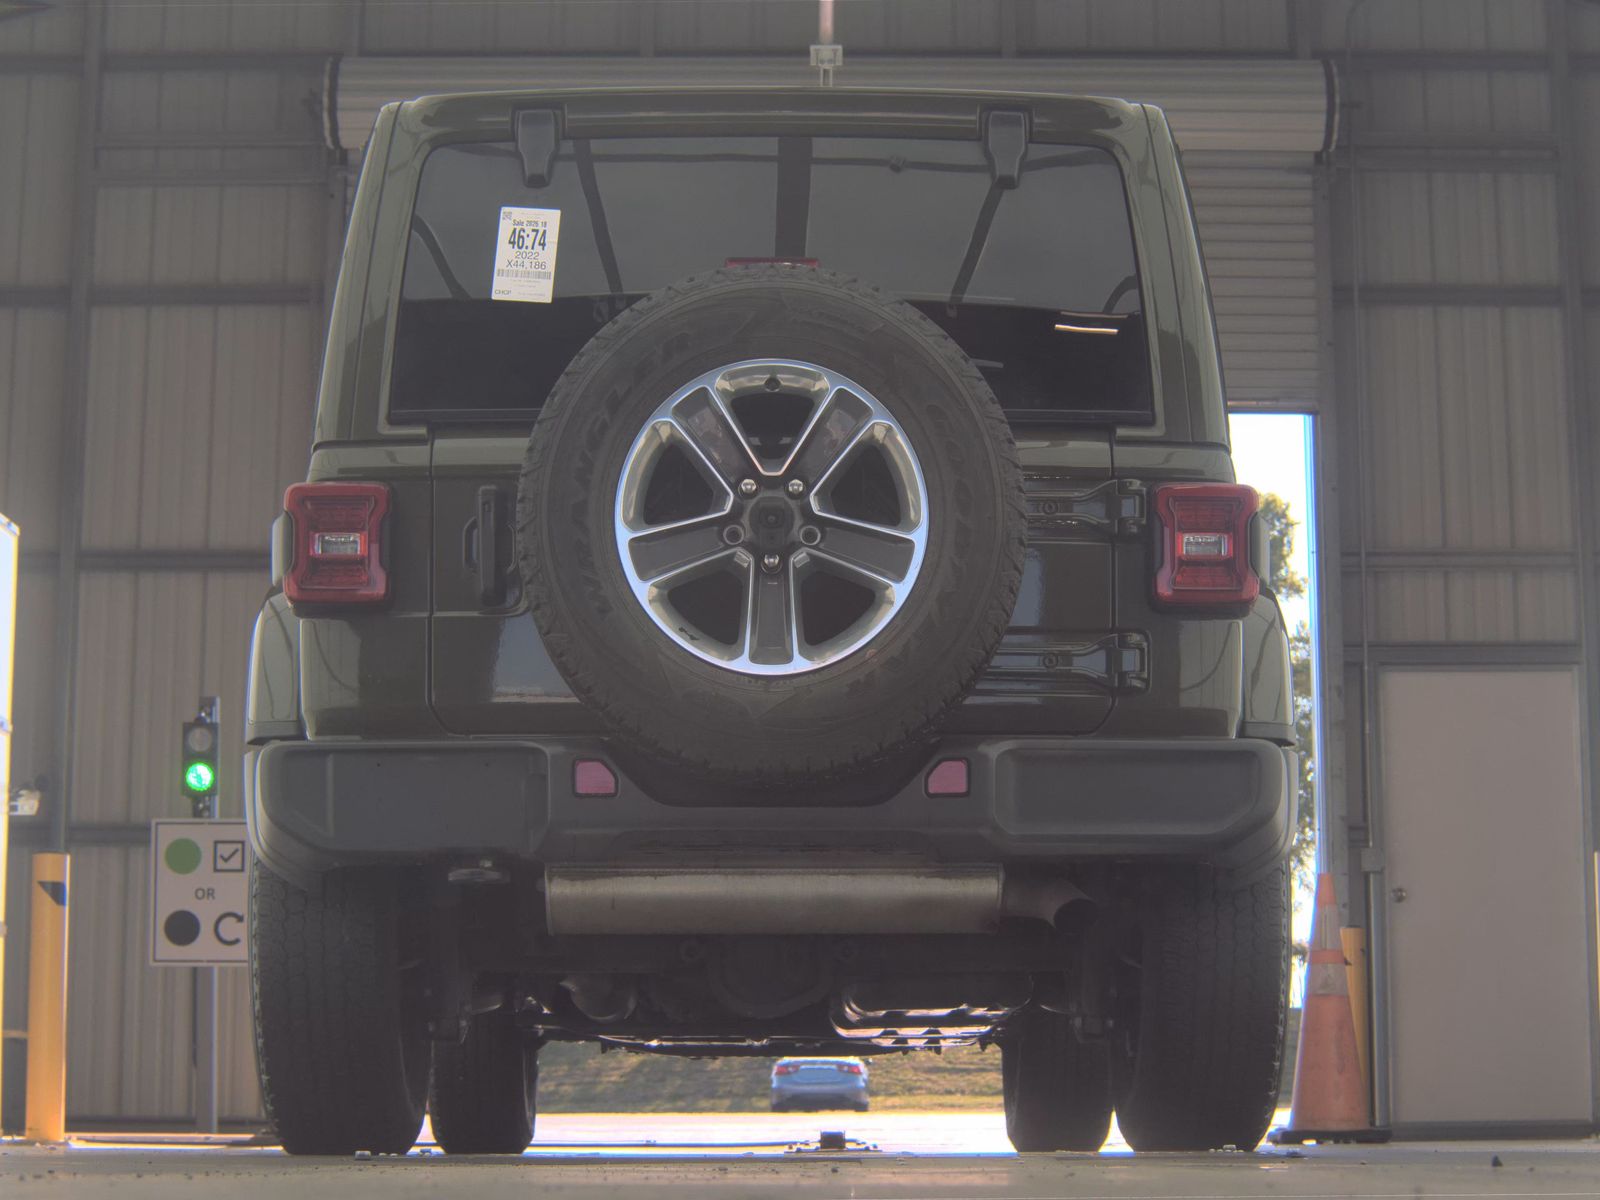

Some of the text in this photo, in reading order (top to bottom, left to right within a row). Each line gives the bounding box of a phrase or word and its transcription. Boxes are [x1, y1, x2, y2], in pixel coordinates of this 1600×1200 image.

[512, 219, 524, 227] Sale
[508, 228, 547, 251] 46:74
[514, 251, 540, 260] 2022
[194, 887, 216, 901] OR
